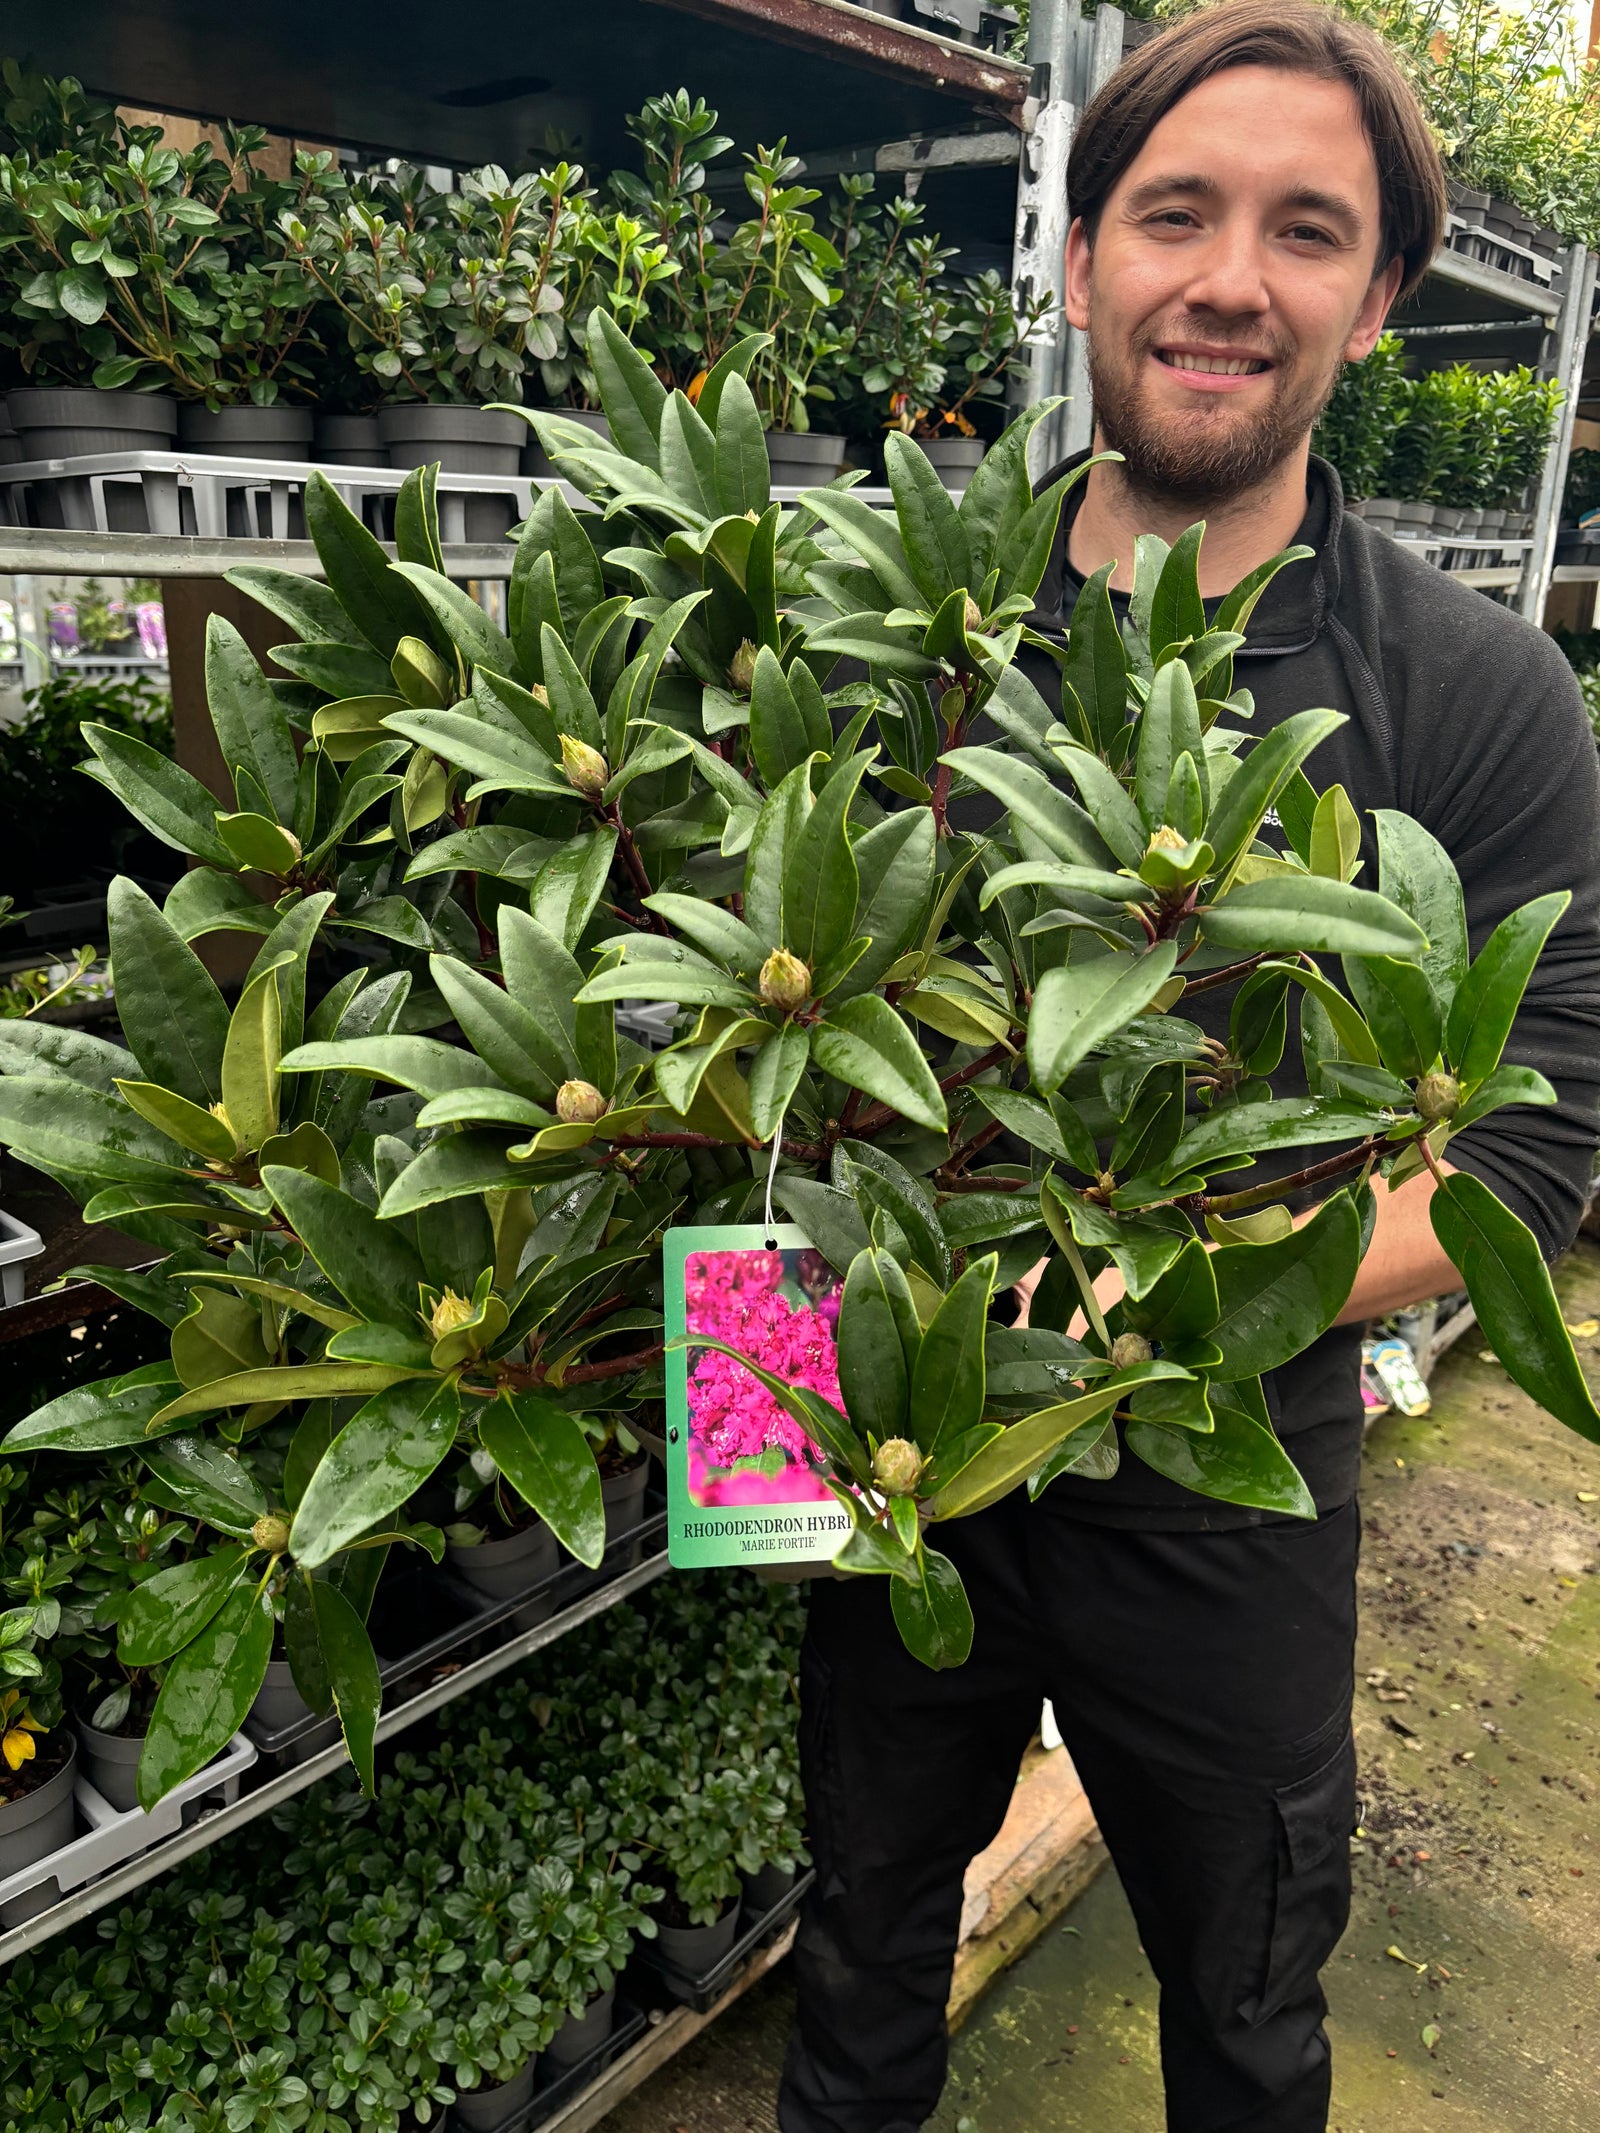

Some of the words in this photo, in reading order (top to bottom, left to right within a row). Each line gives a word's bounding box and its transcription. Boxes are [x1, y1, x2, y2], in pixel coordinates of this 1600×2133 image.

[683, 1518, 803, 1538] RHODODENDRON
[807, 1515, 853, 1531] HYBRI
[740, 1539, 776, 1552] 'MARIE
[778, 1537, 817, 1549] FORTIE'
